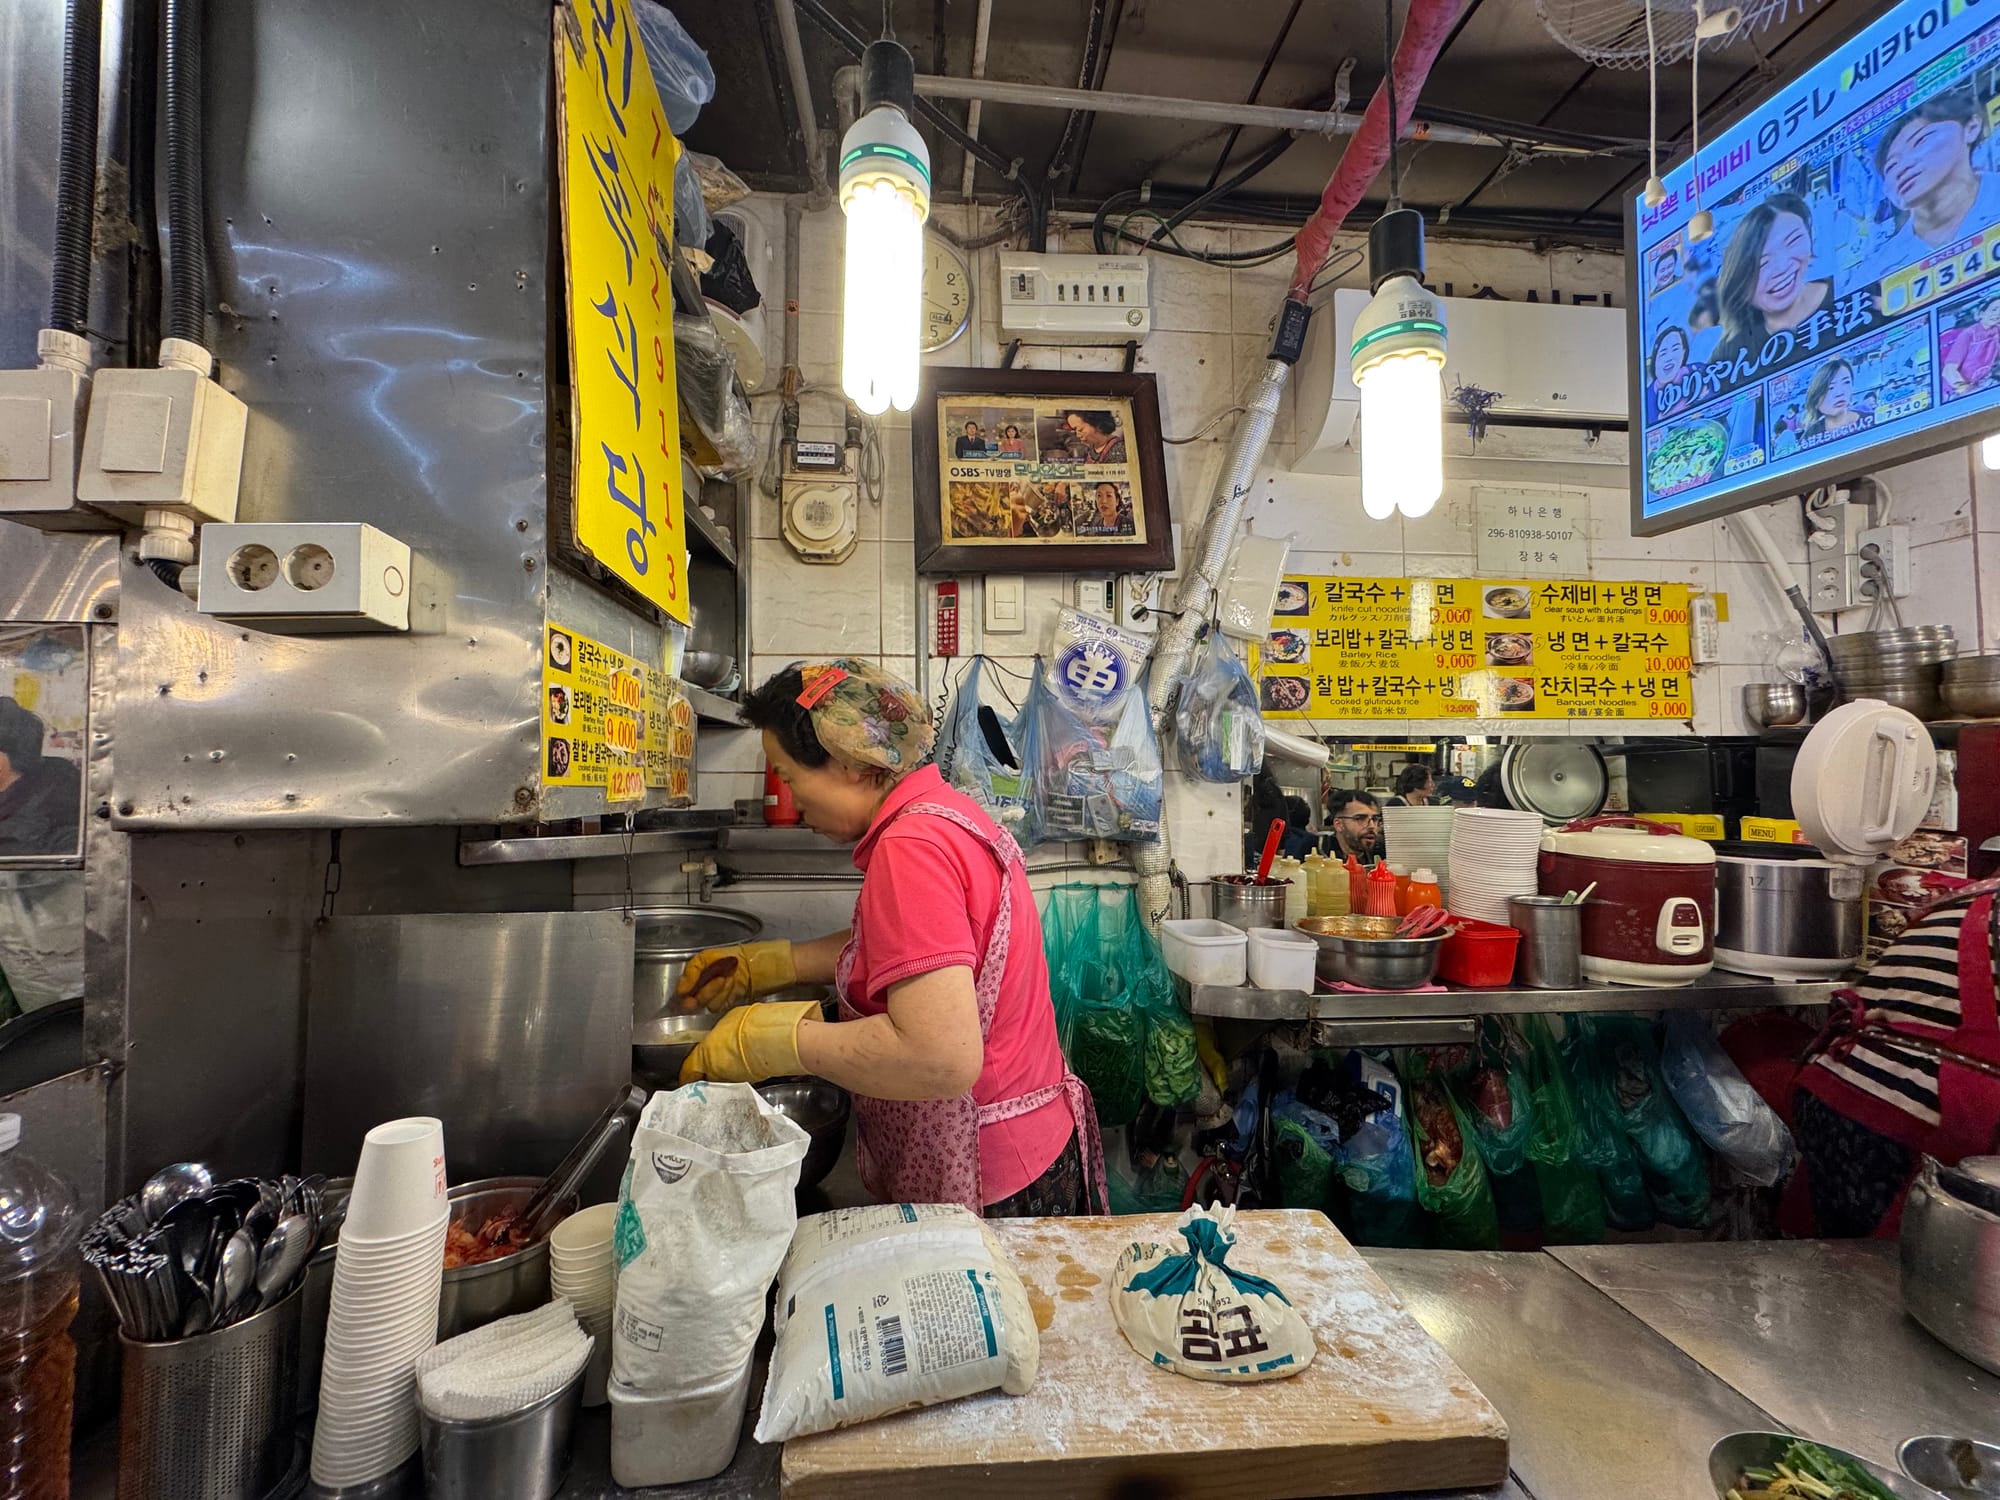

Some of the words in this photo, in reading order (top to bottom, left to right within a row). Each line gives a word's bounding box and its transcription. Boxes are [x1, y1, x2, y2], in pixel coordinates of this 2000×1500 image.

[946, 272, 956, 286] 2
[951, 293, 960, 306] 3
[930, 325, 938, 338] 5
[1656, 292, 1874, 414] ゆりやんの手法
[1487, 528, 1573, 541] 296-810938-50107
[1324, 582, 1455, 605] 칼국수+면
[1331, 605, 1354, 613] knife
[1604, 607, 1642, 615] dumplings
[1430, 608, 1471, 625] 9.000
[1649, 609, 1686, 624] 9.000
[1340, 651, 1371, 659] Barley
[1436, 654, 1474, 669] 9.000
[1584, 653, 1621, 661] noodles
[1646, 657, 1691, 672] 10.000
[611, 674, 640, 709] 9.000
[1316, 675, 1461, 697] 찰밥+칼국수+냉
[1364, 699, 1401, 707] glutinous
[1557, 699, 1596, 707] Banquet
[1650, 702, 1686, 716] 9.000
[607, 718, 636, 750] 9.000
[1750, 828, 1775, 838] MENU
